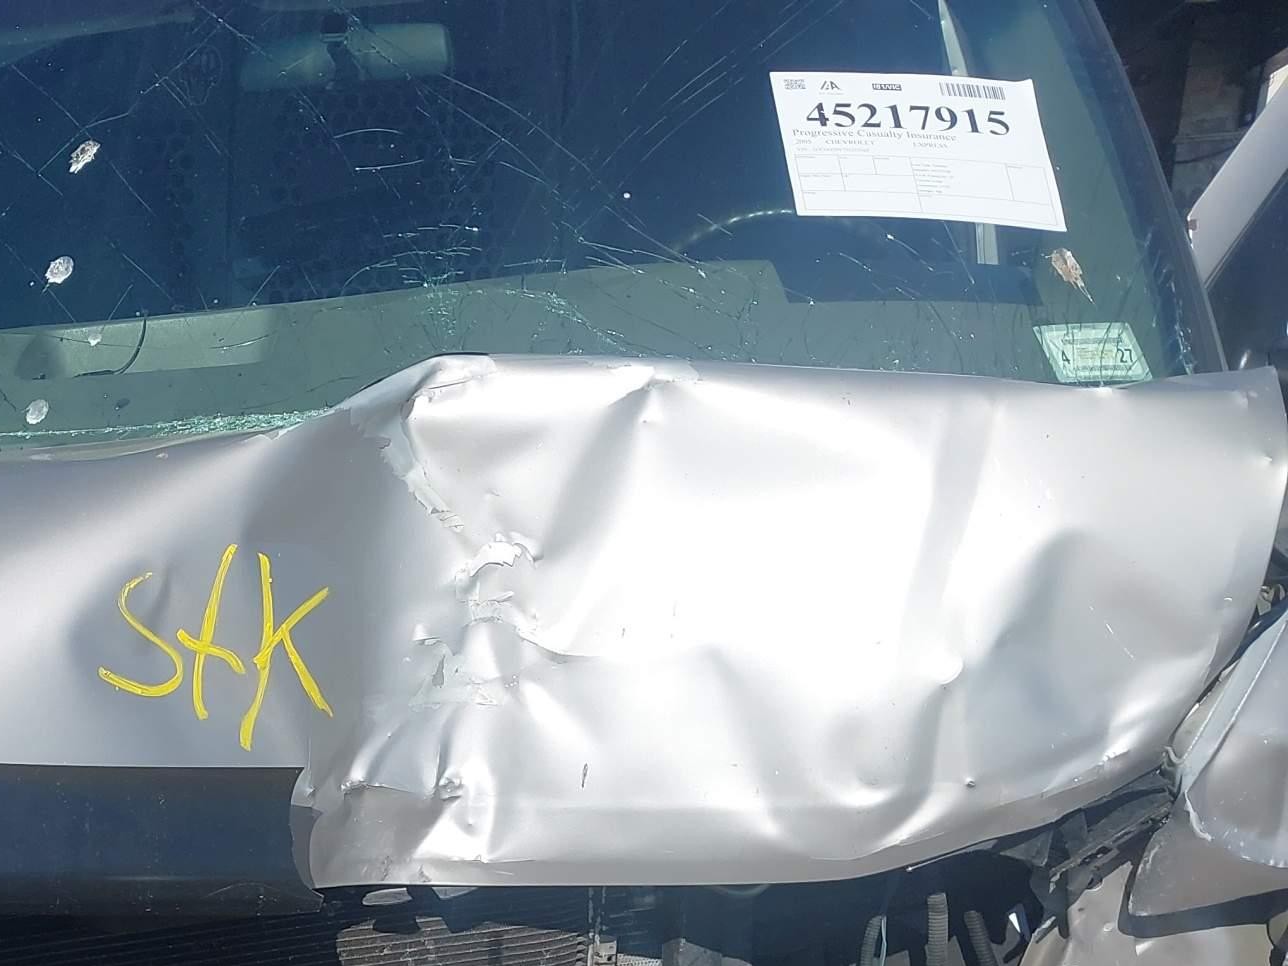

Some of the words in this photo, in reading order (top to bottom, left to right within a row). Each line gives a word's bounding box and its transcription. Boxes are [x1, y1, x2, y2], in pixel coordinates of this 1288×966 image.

[806, 102, 1010, 136] 45217915
[792, 129, 854, 138] Progressive
[857, 129, 903, 139] Casualty
[906, 131, 957, 142] Insurance
[1117, 348, 1134, 363] 27
